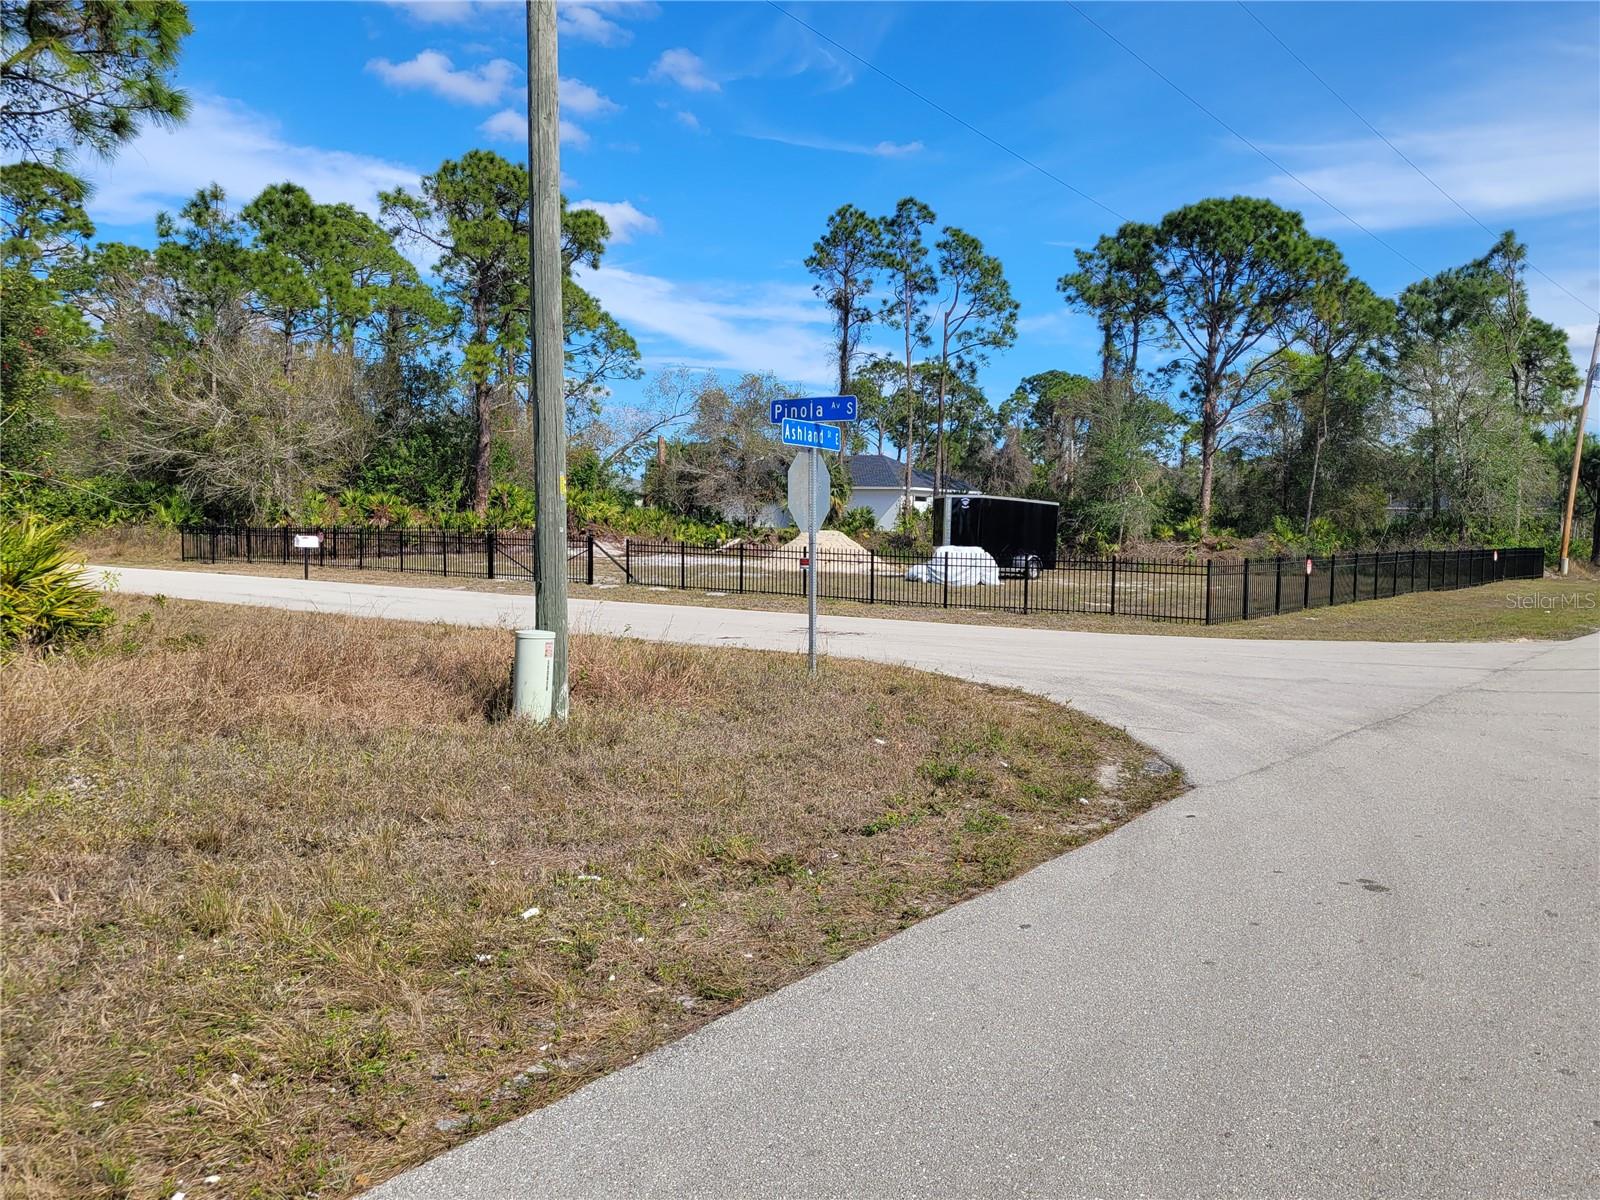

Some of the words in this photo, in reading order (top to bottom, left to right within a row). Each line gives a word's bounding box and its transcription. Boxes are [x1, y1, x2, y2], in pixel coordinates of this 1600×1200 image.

[774, 400, 823, 419] Pinola
[846, 401, 853, 415] S
[784, 423, 824, 444] Ashland
[835, 432, 839, 446] E
